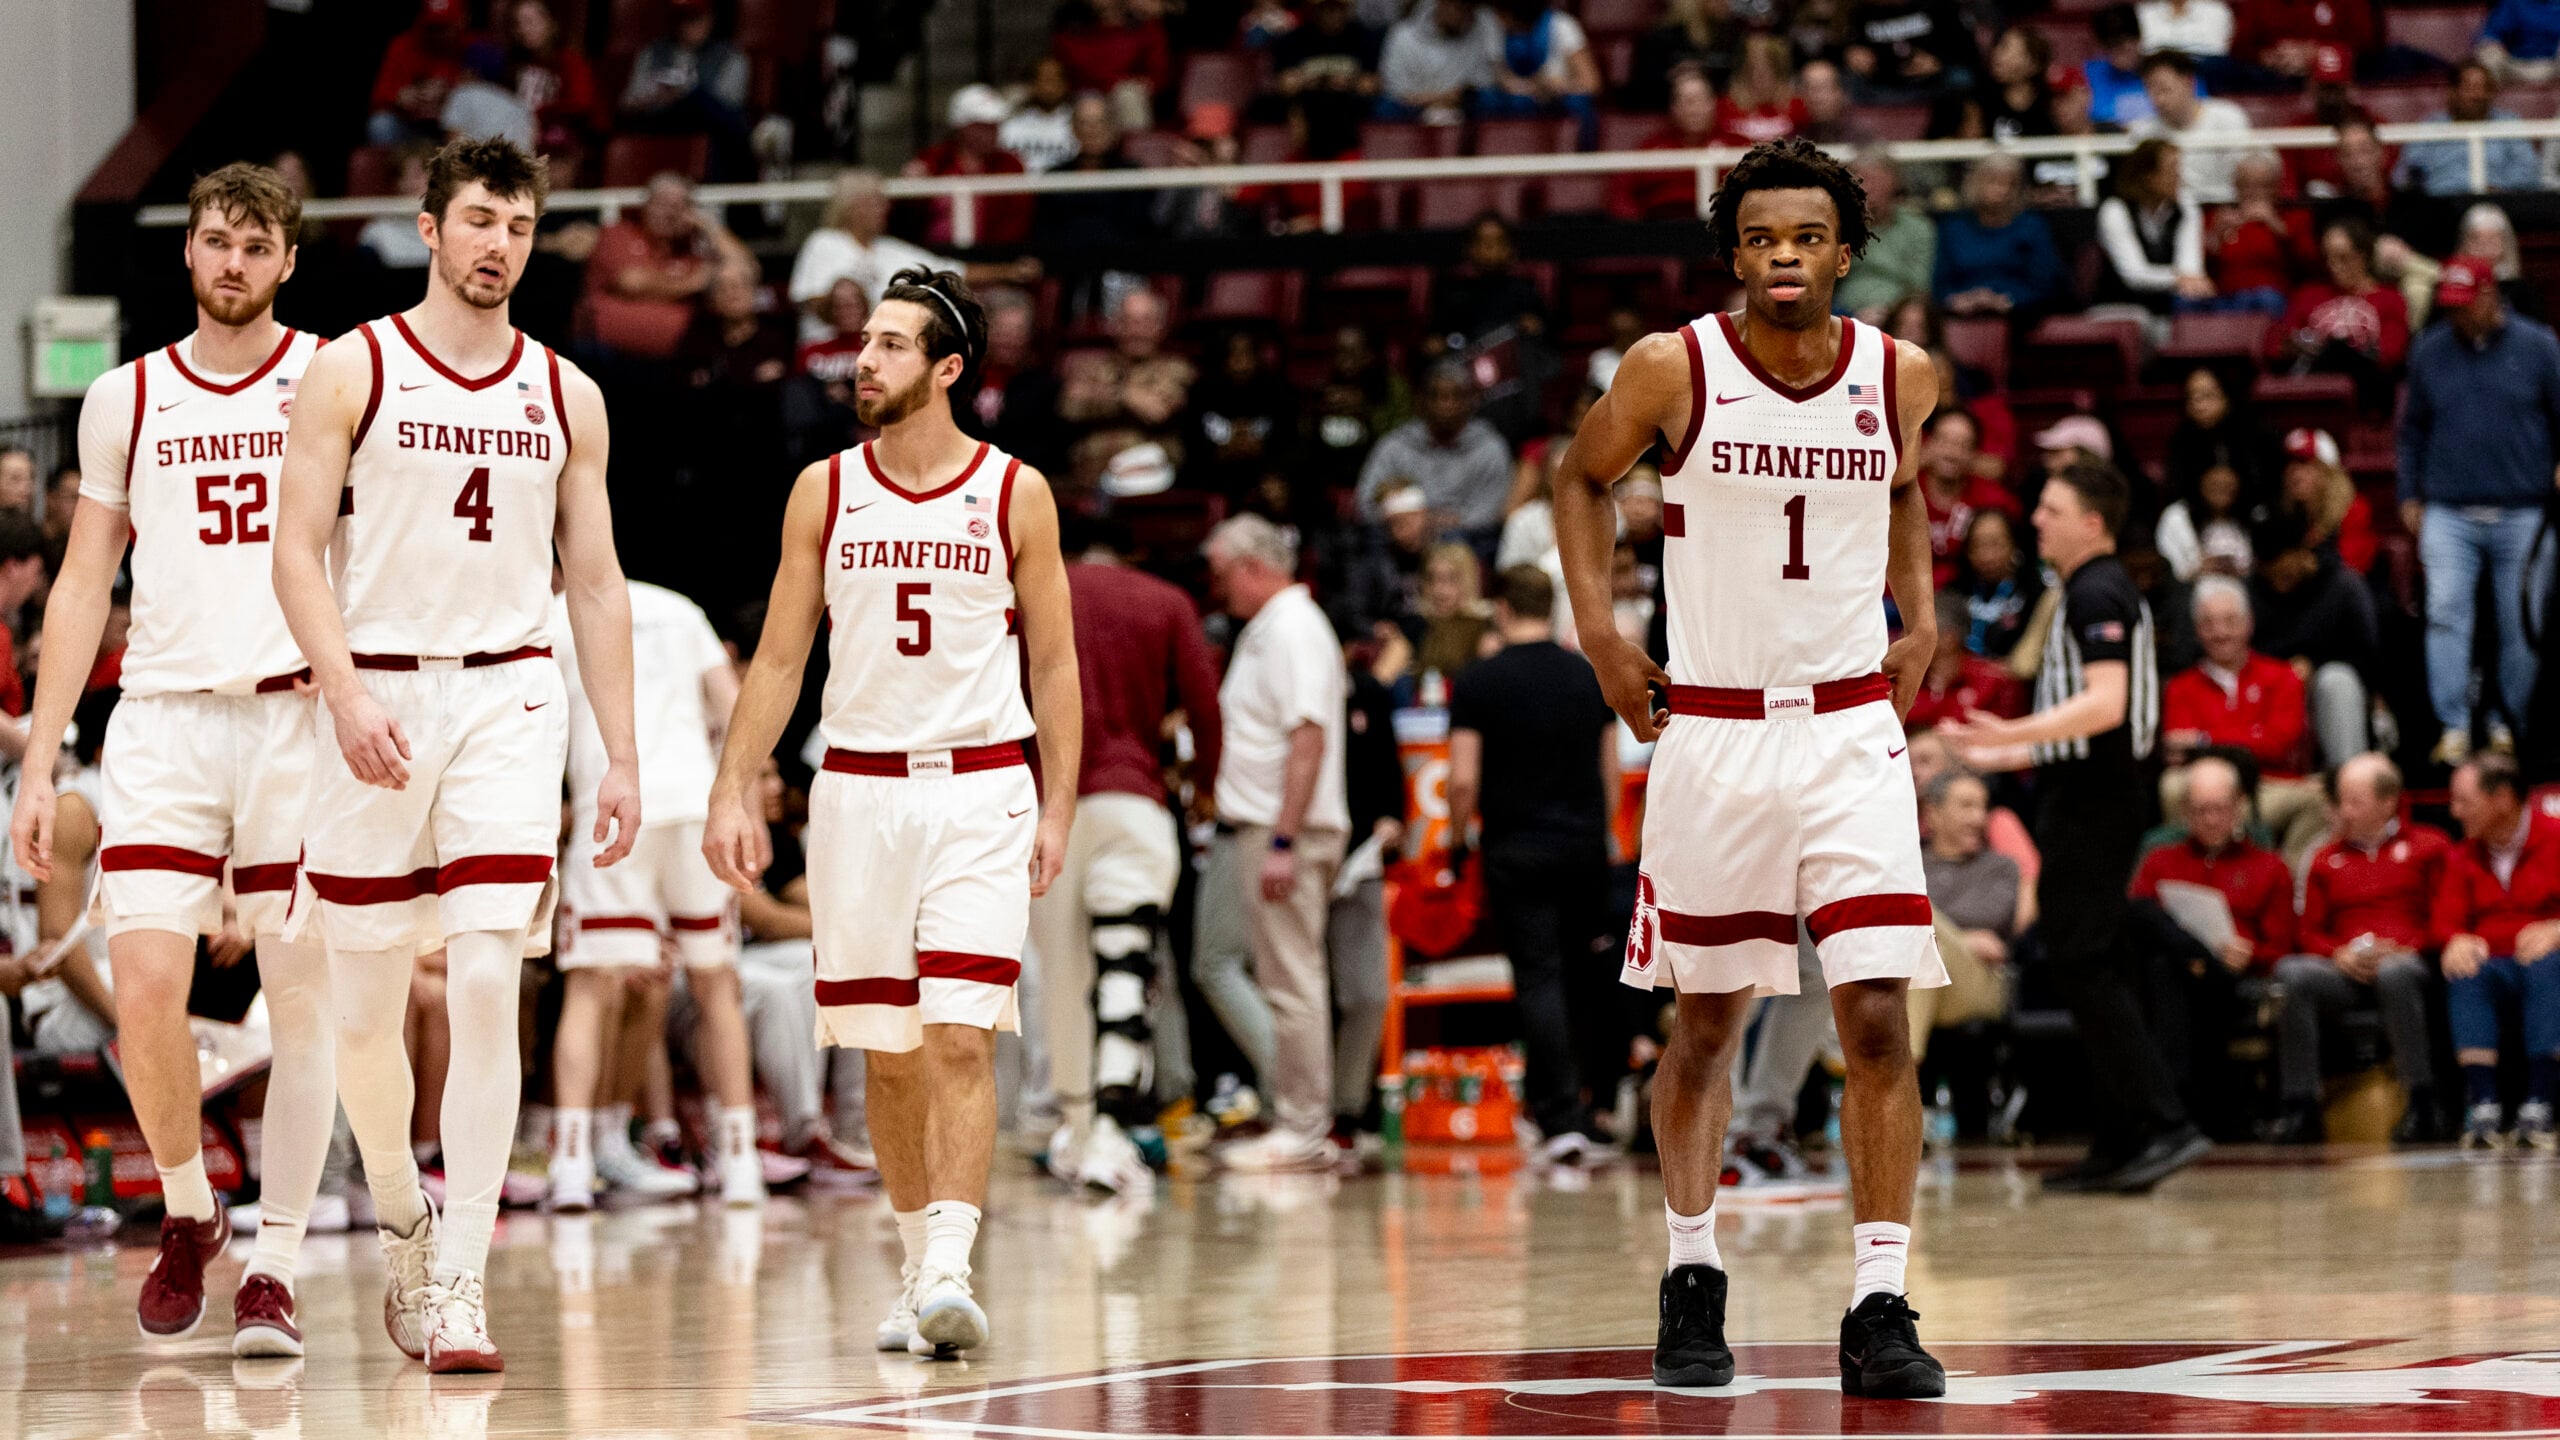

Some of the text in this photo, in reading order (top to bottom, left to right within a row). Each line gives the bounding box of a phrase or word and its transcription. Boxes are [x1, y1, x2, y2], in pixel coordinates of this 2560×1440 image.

[157, 431, 288, 467] STANFOR
[398, 421, 550, 461] STANFORD
[1712, 441, 1886, 481] STANFORD
[196, 473, 270, 545] 52
[453, 467, 493, 543] 4
[1782, 495, 1810, 580] 1
[841, 541, 991, 575] STANFORD
[896, 583, 932, 656] 5
[1769, 698, 1810, 709] CARDINAL
[911, 760, 948, 770] CARDINAL
